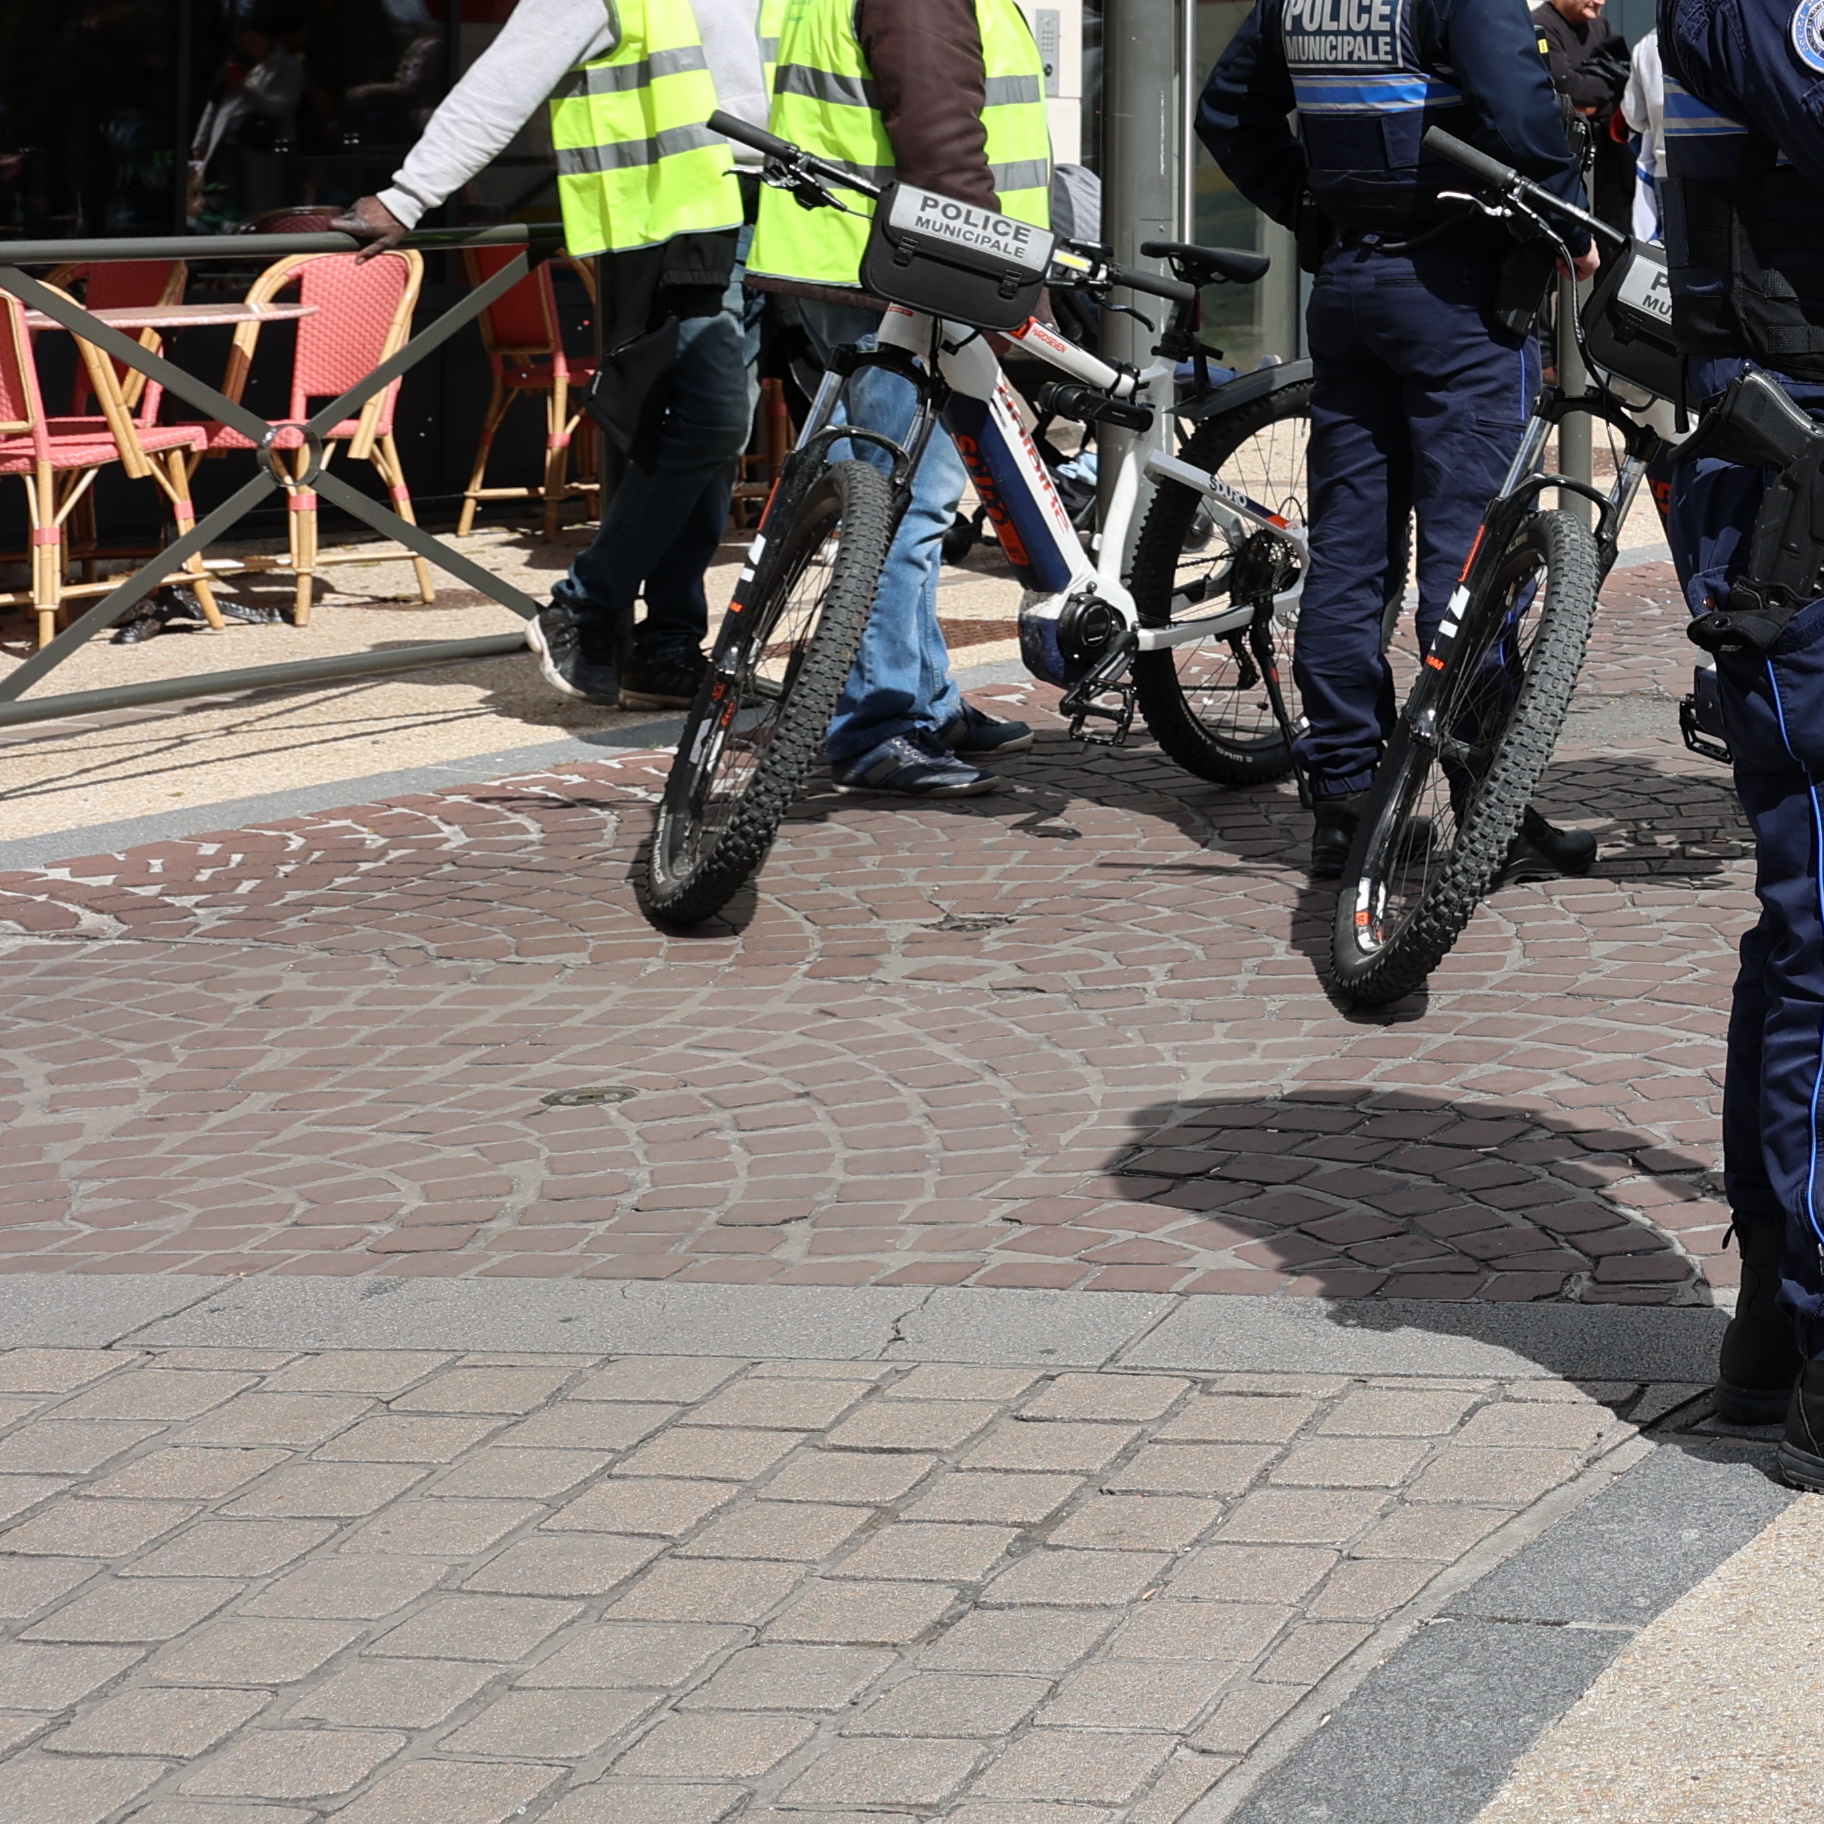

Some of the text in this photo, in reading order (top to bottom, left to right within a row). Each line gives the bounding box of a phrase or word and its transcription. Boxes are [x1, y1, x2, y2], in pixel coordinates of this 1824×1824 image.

[1286, 35, 1393, 61] MUNICIPALE
[915, 216, 1026, 259] MUNICIPALE
[920, 195, 1031, 245] POLICE
